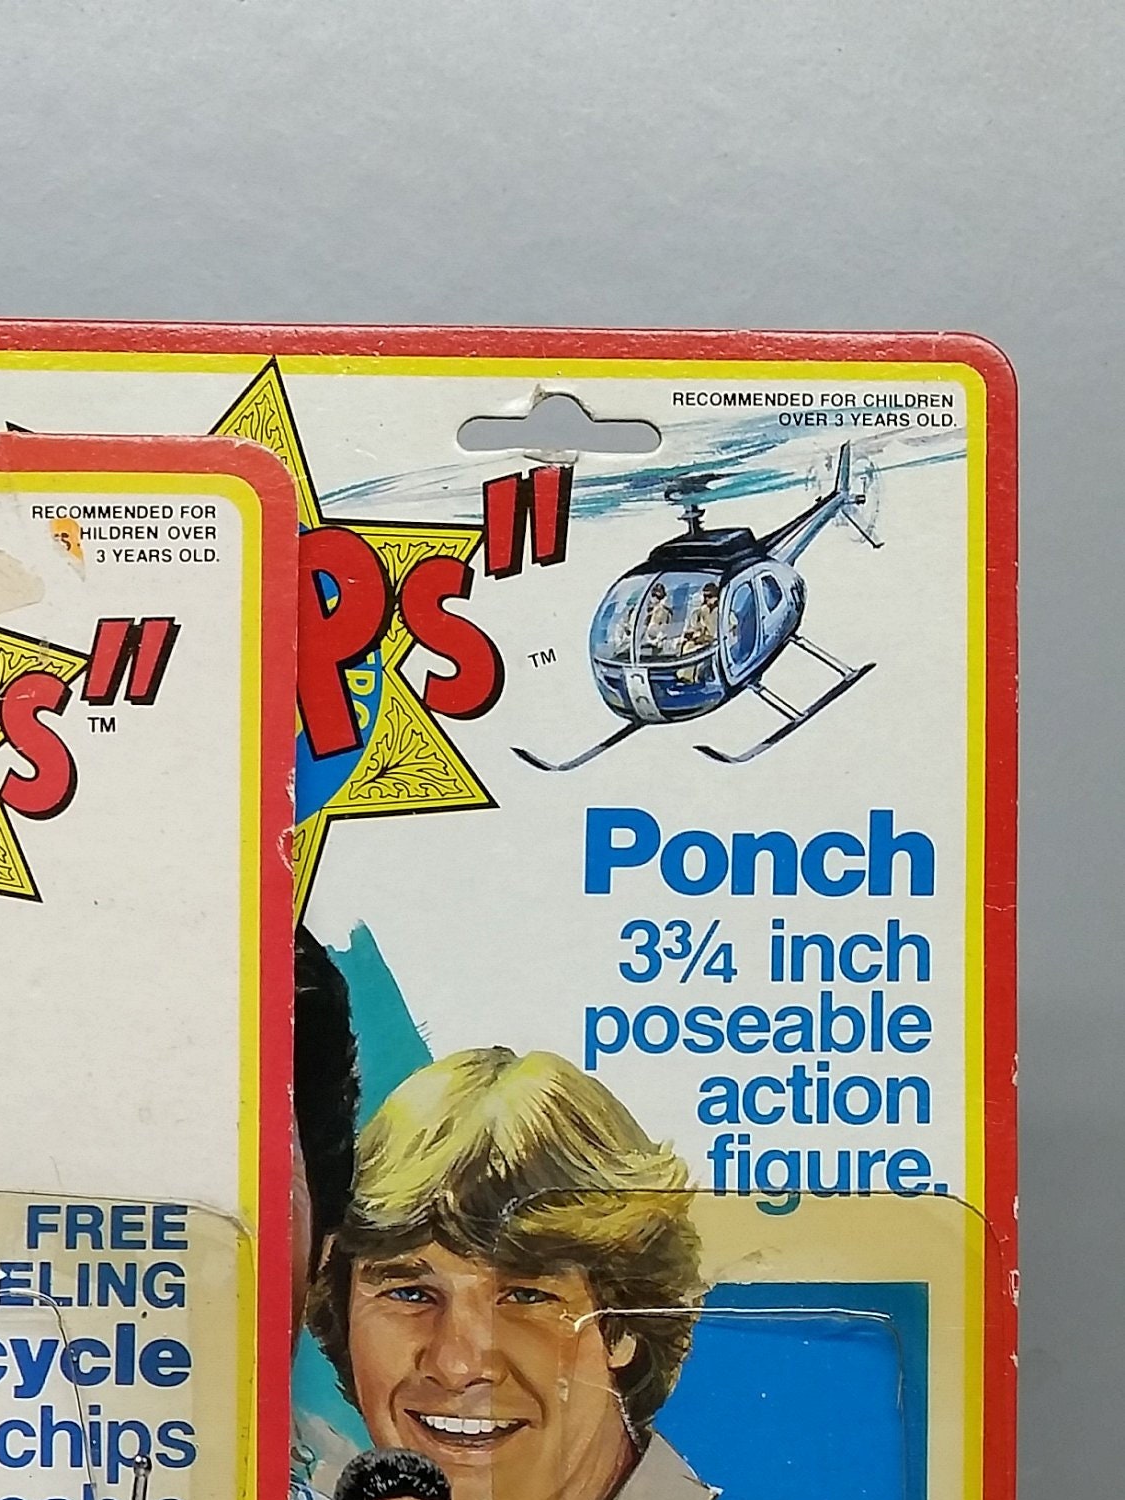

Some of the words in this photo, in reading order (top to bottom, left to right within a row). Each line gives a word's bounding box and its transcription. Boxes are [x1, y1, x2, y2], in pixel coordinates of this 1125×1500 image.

[672, 391, 814, 408] RECOMMENDED
[820, 392, 857, 408] FOR
[862, 393, 954, 409] CHILDREN
[778, 411, 829, 428] OVER
[833, 412, 845, 428] 3
[850, 411, 911, 428] YEARS
[915, 412, 958, 428] OLD.
[31, 504, 174, 519] RECOMMENDED
[179, 505, 217, 519] FOR
[80, 525, 159, 541] HILDREN
[167, 525, 217, 541] OVER
[96, 548, 106, 563] 3
[112, 548, 173, 563] YEARS
[179, 548, 220, 563] OLD.
[528, 648, 557, 668] TM
[87, 716, 117, 733] TM
[584, 807, 935, 897] Ponch
[770, 918, 931, 983] inch
[584, 990, 932, 1071] poseable
[697, 1060, 931, 1126] action
[707, 1133, 949, 1216] figure.
[29, 1206, 188, 1249] FREE
